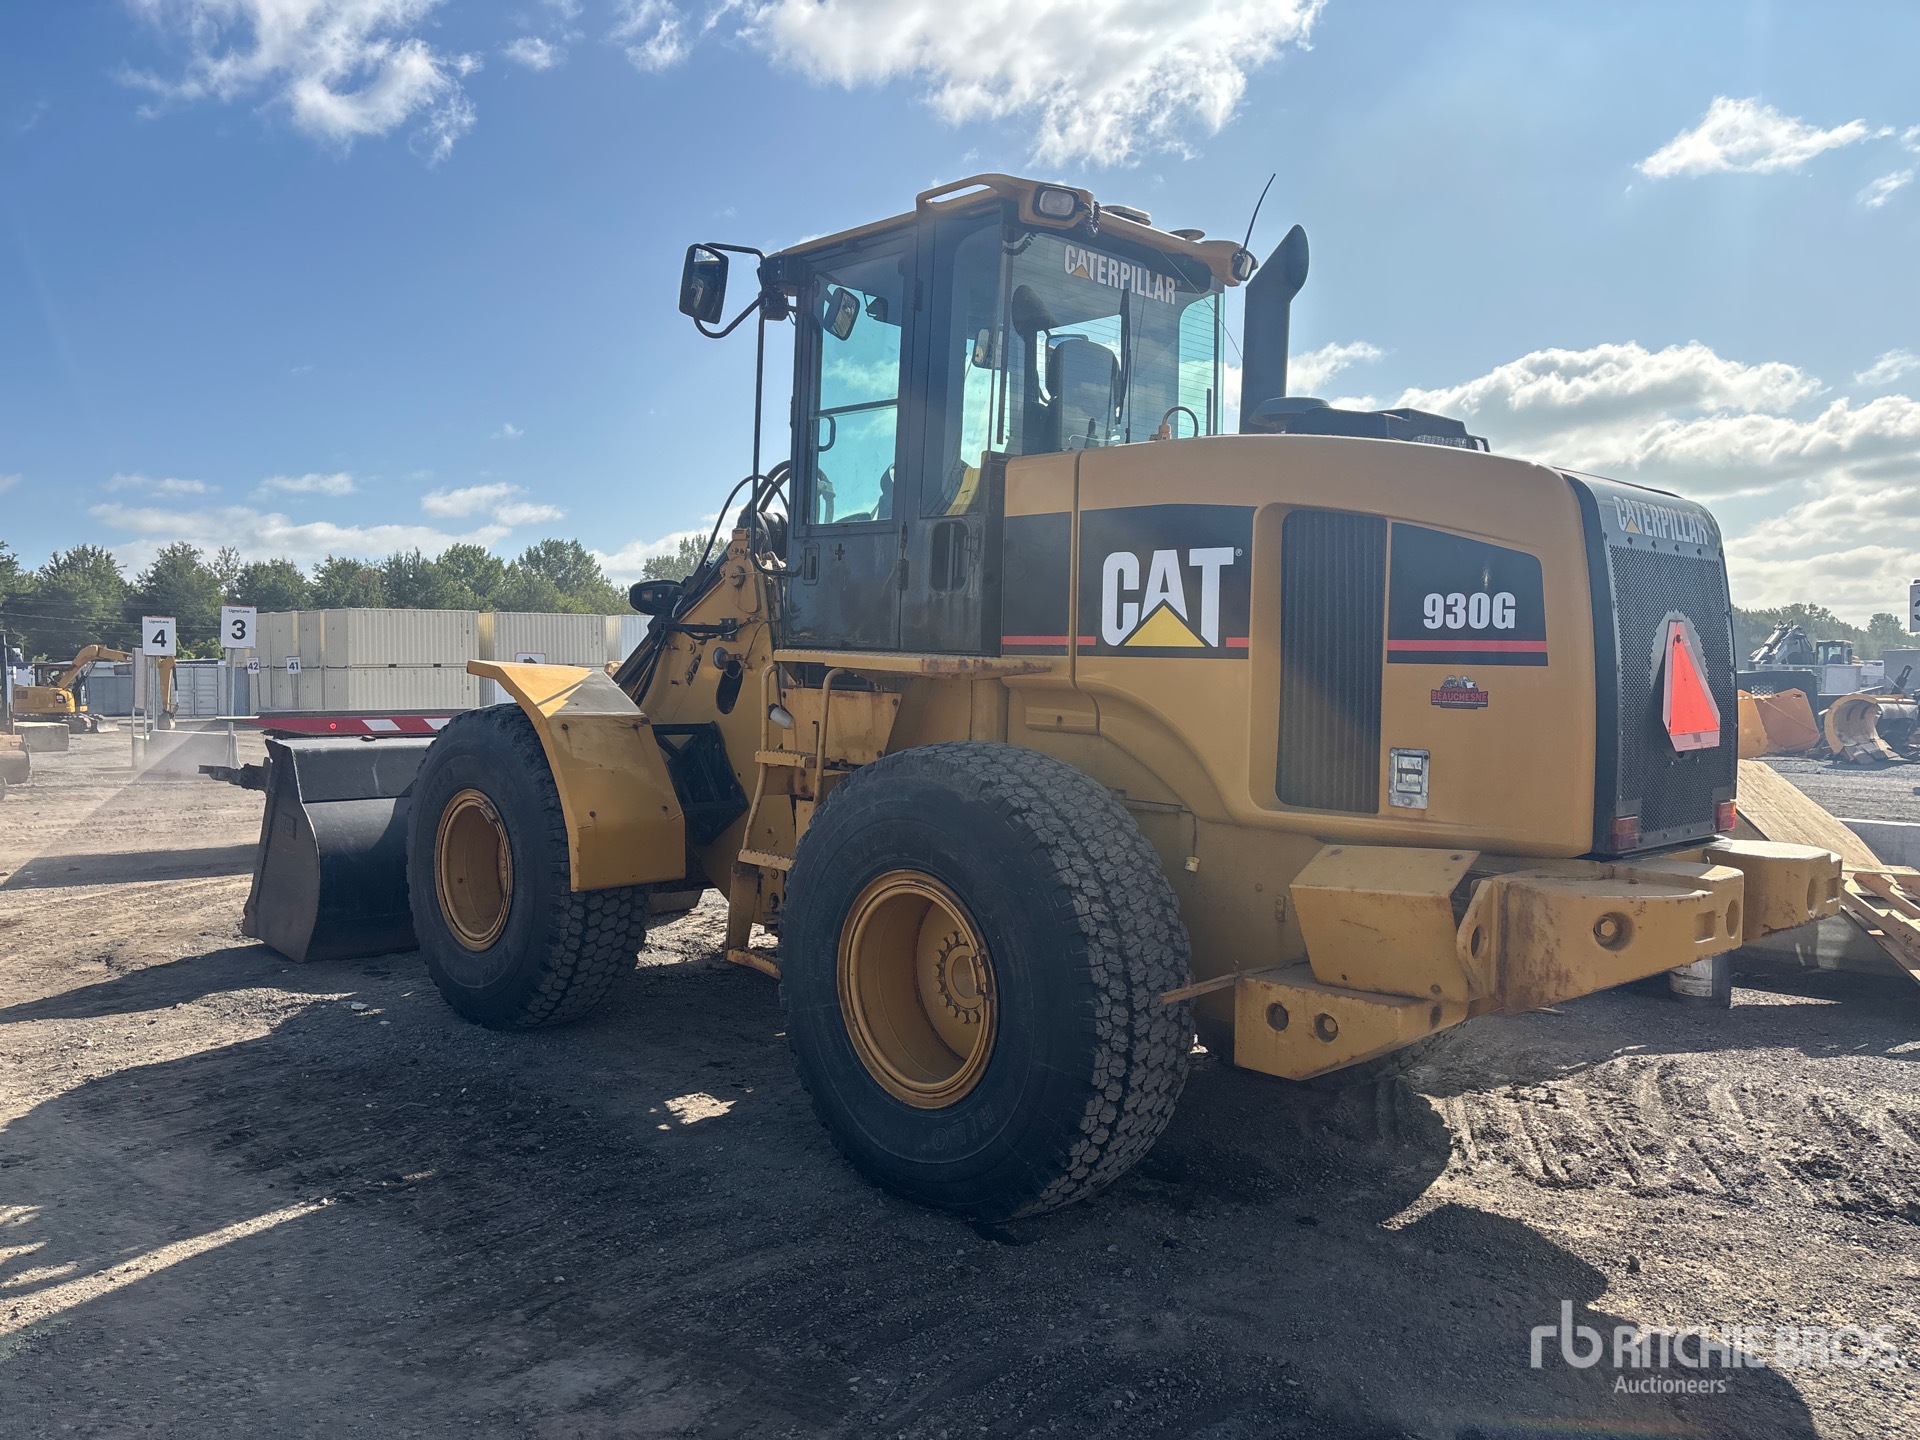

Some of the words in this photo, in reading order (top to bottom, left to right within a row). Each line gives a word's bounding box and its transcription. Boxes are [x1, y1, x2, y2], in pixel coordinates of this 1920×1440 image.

[1063, 244, 1177, 305] CATERPILLAR
[1613, 496, 1709, 546] CATERPILLAR
[1101, 546, 1235, 648] CAT
[1423, 591, 1516, 630] 930G
[152, 629, 167, 648] 4
[231, 619, 246, 640] 3
[247, 661, 259, 670] 42
[288, 661, 299, 670] 41
[1431, 690, 1488, 702] BEAUCHESNE
